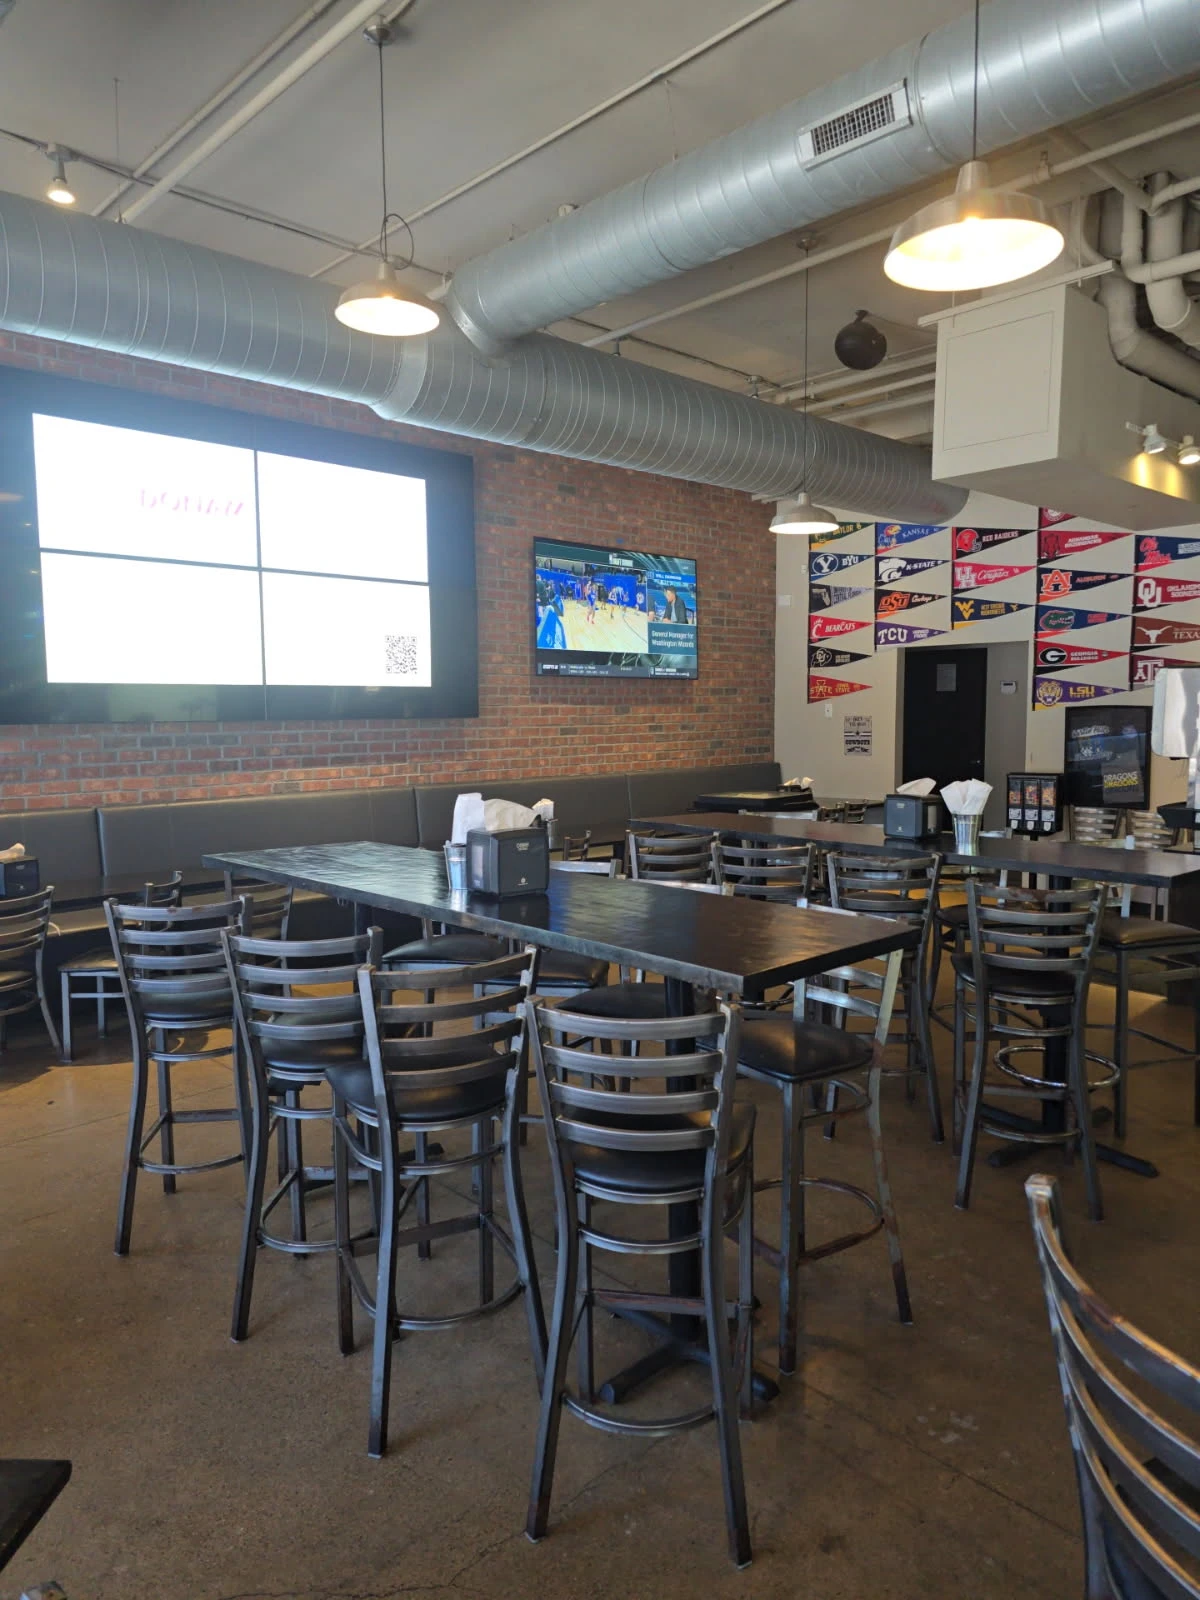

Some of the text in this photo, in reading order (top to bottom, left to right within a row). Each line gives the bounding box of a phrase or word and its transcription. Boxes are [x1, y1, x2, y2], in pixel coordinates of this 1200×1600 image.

[902, 527, 930, 539] KANSAS
[982, 530, 1019, 542] RED RAIDERS
[842, 555, 859, 566] BYU
[905, 560, 936, 571] K-STATE
[824, 622, 856, 633] BEARCATS
[878, 628, 908, 645] TCU
[1069, 686, 1095, 696] LSU
[1103, 771, 1138, 781] DRAGONS
